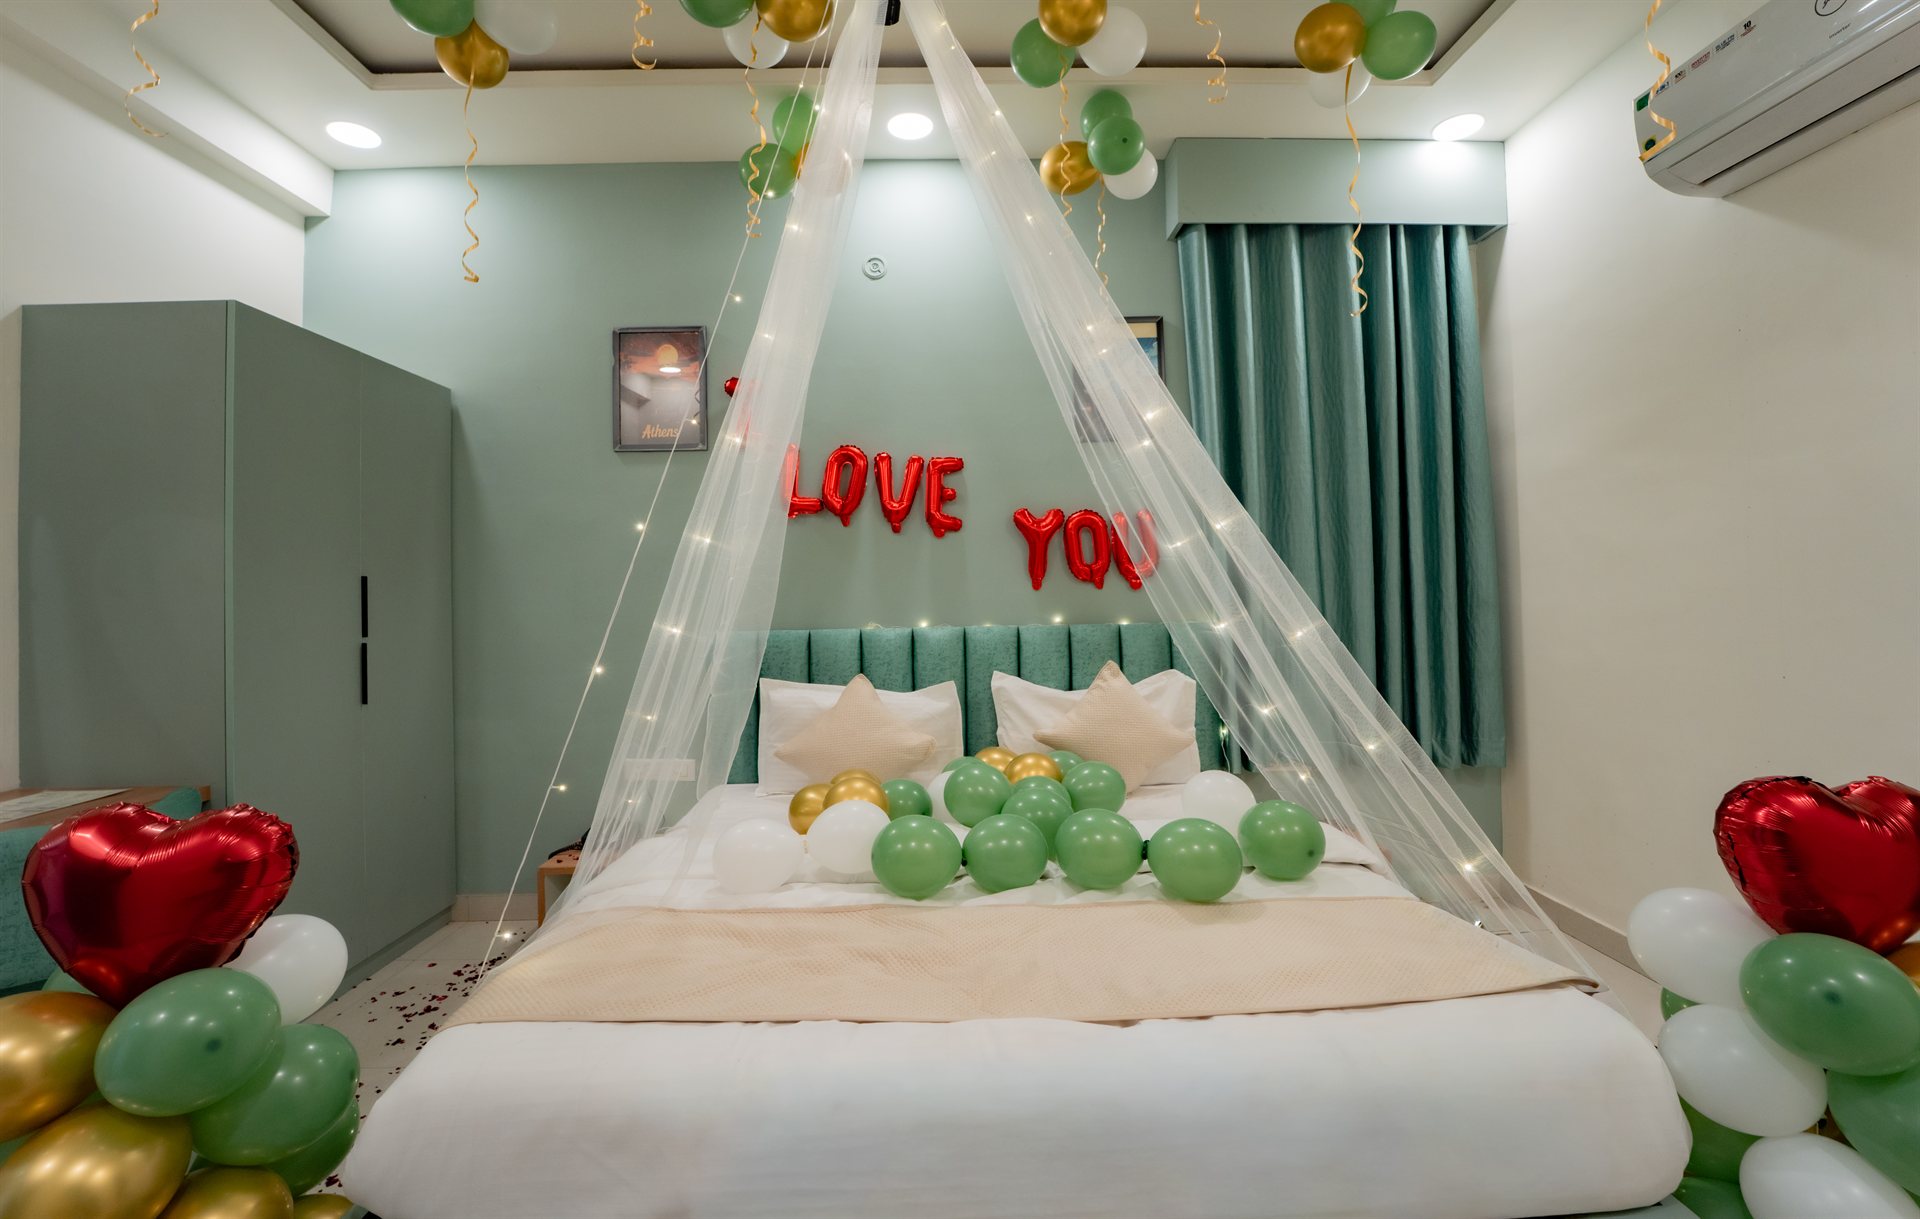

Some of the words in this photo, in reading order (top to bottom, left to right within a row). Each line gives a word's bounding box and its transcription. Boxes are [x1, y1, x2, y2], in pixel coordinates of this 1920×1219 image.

[1743, 20, 1752, 30] 10
[641, 424, 679, 439] Athens
[783, 443, 965, 538] LOVE
[1012, 507, 1160, 591] YOU
